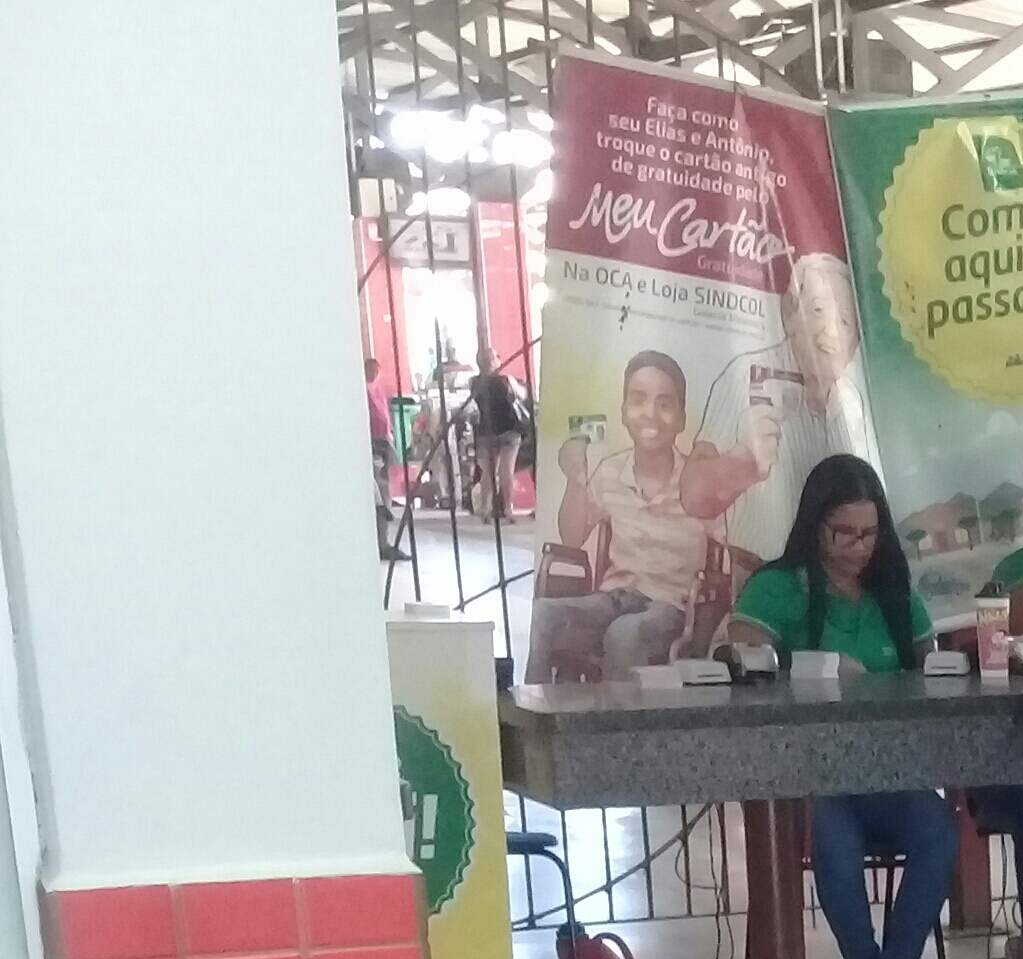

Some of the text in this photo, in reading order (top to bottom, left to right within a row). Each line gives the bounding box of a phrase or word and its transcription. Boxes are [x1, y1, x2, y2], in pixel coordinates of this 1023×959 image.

[609, 113, 640, 132] seu
[645, 118, 686, 143] Elias
[691, 130, 701, 146] e
[647, 96, 739, 131] Faça como
[596, 130, 787, 189] troque o cartão anto
[611, 155, 634, 175] de
[637, 163, 733, 196] gratuidade
[569, 182, 796, 263] Meu Cartão
[944, 233, 1023, 288] aqui
[563, 260, 590, 282] Na
[595, 266, 633, 291] OCA
[637, 280, 647, 293] e
[652, 278, 689, 303] Loja
[694, 286, 766, 318] SINDCOL
